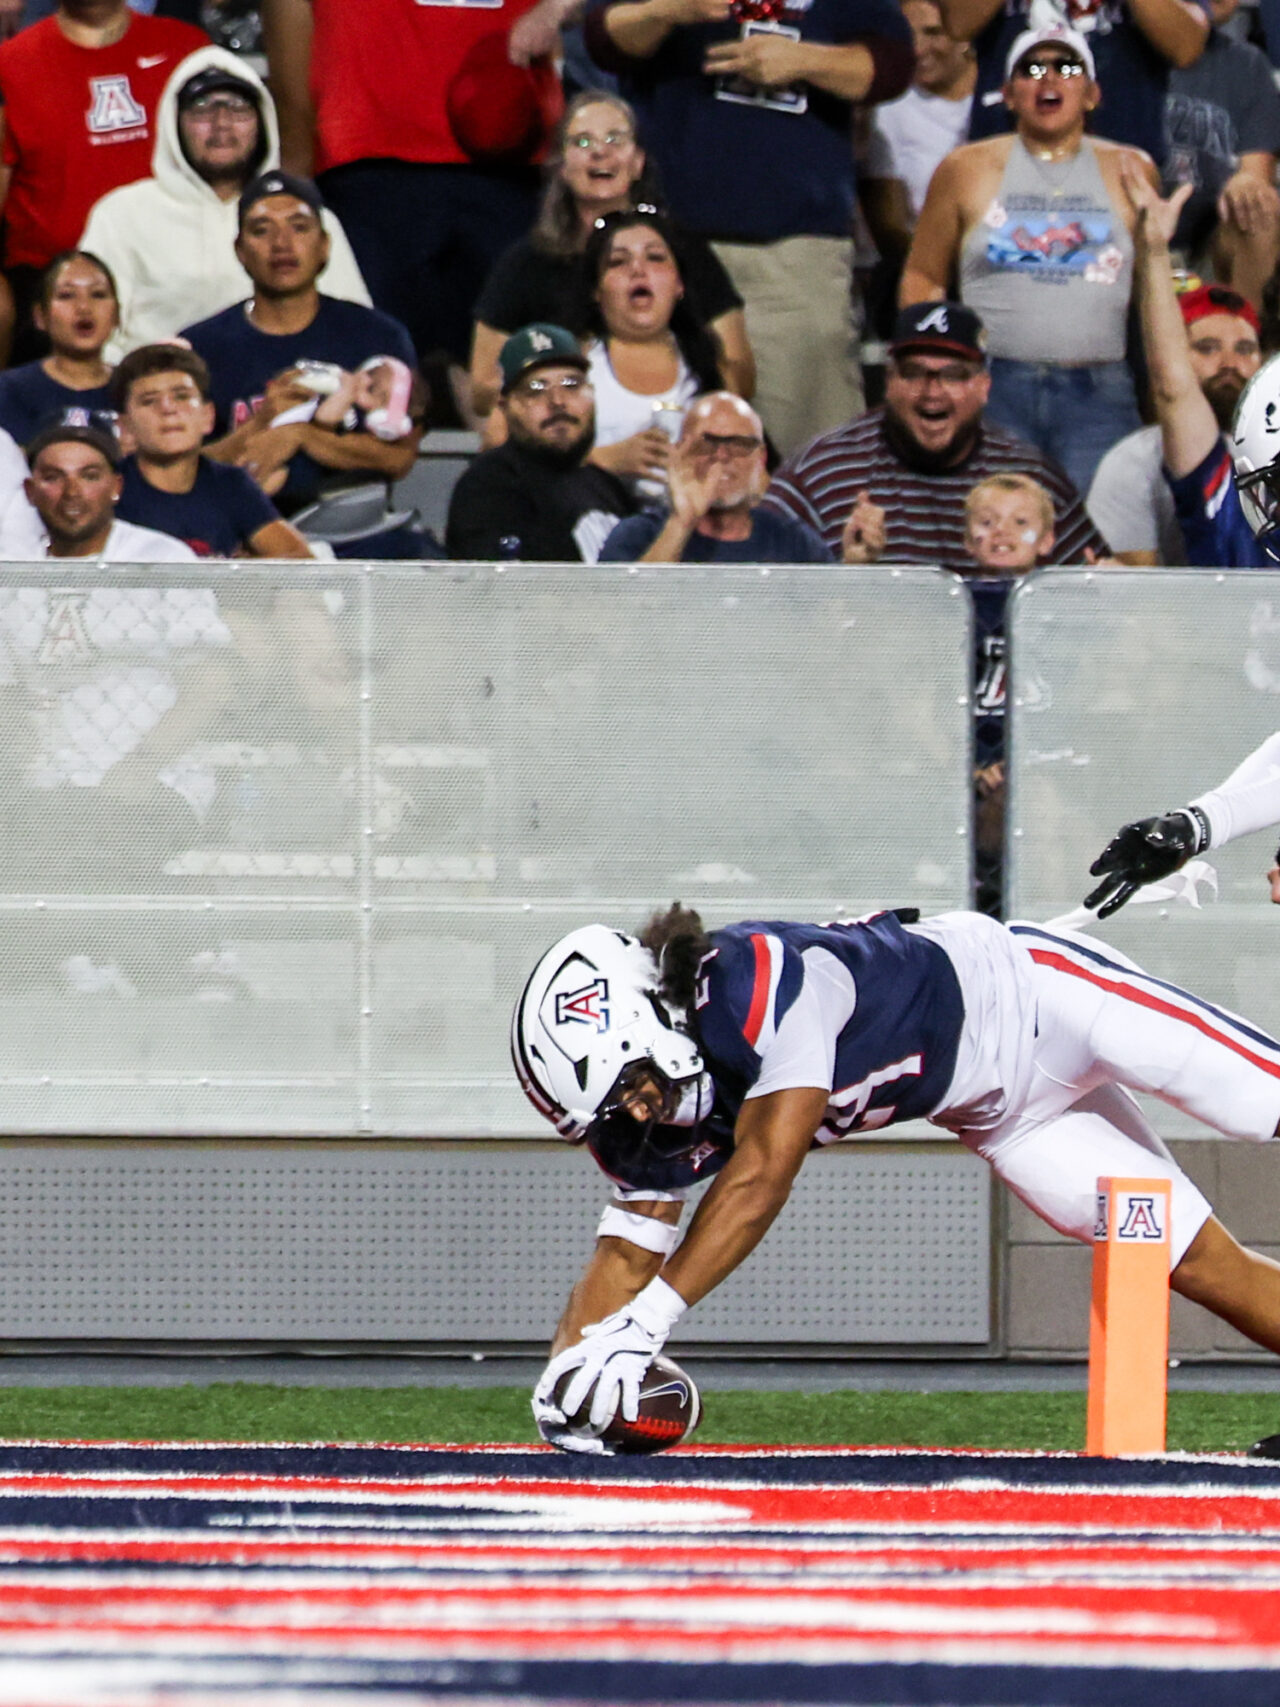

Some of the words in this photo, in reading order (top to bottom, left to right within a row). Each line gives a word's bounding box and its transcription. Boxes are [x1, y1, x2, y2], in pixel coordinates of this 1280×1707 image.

[85, 76, 147, 132] A
[915, 305, 949, 333] A
[555, 978, 610, 1034] A
[1118, 1197, 1162, 1238] A
